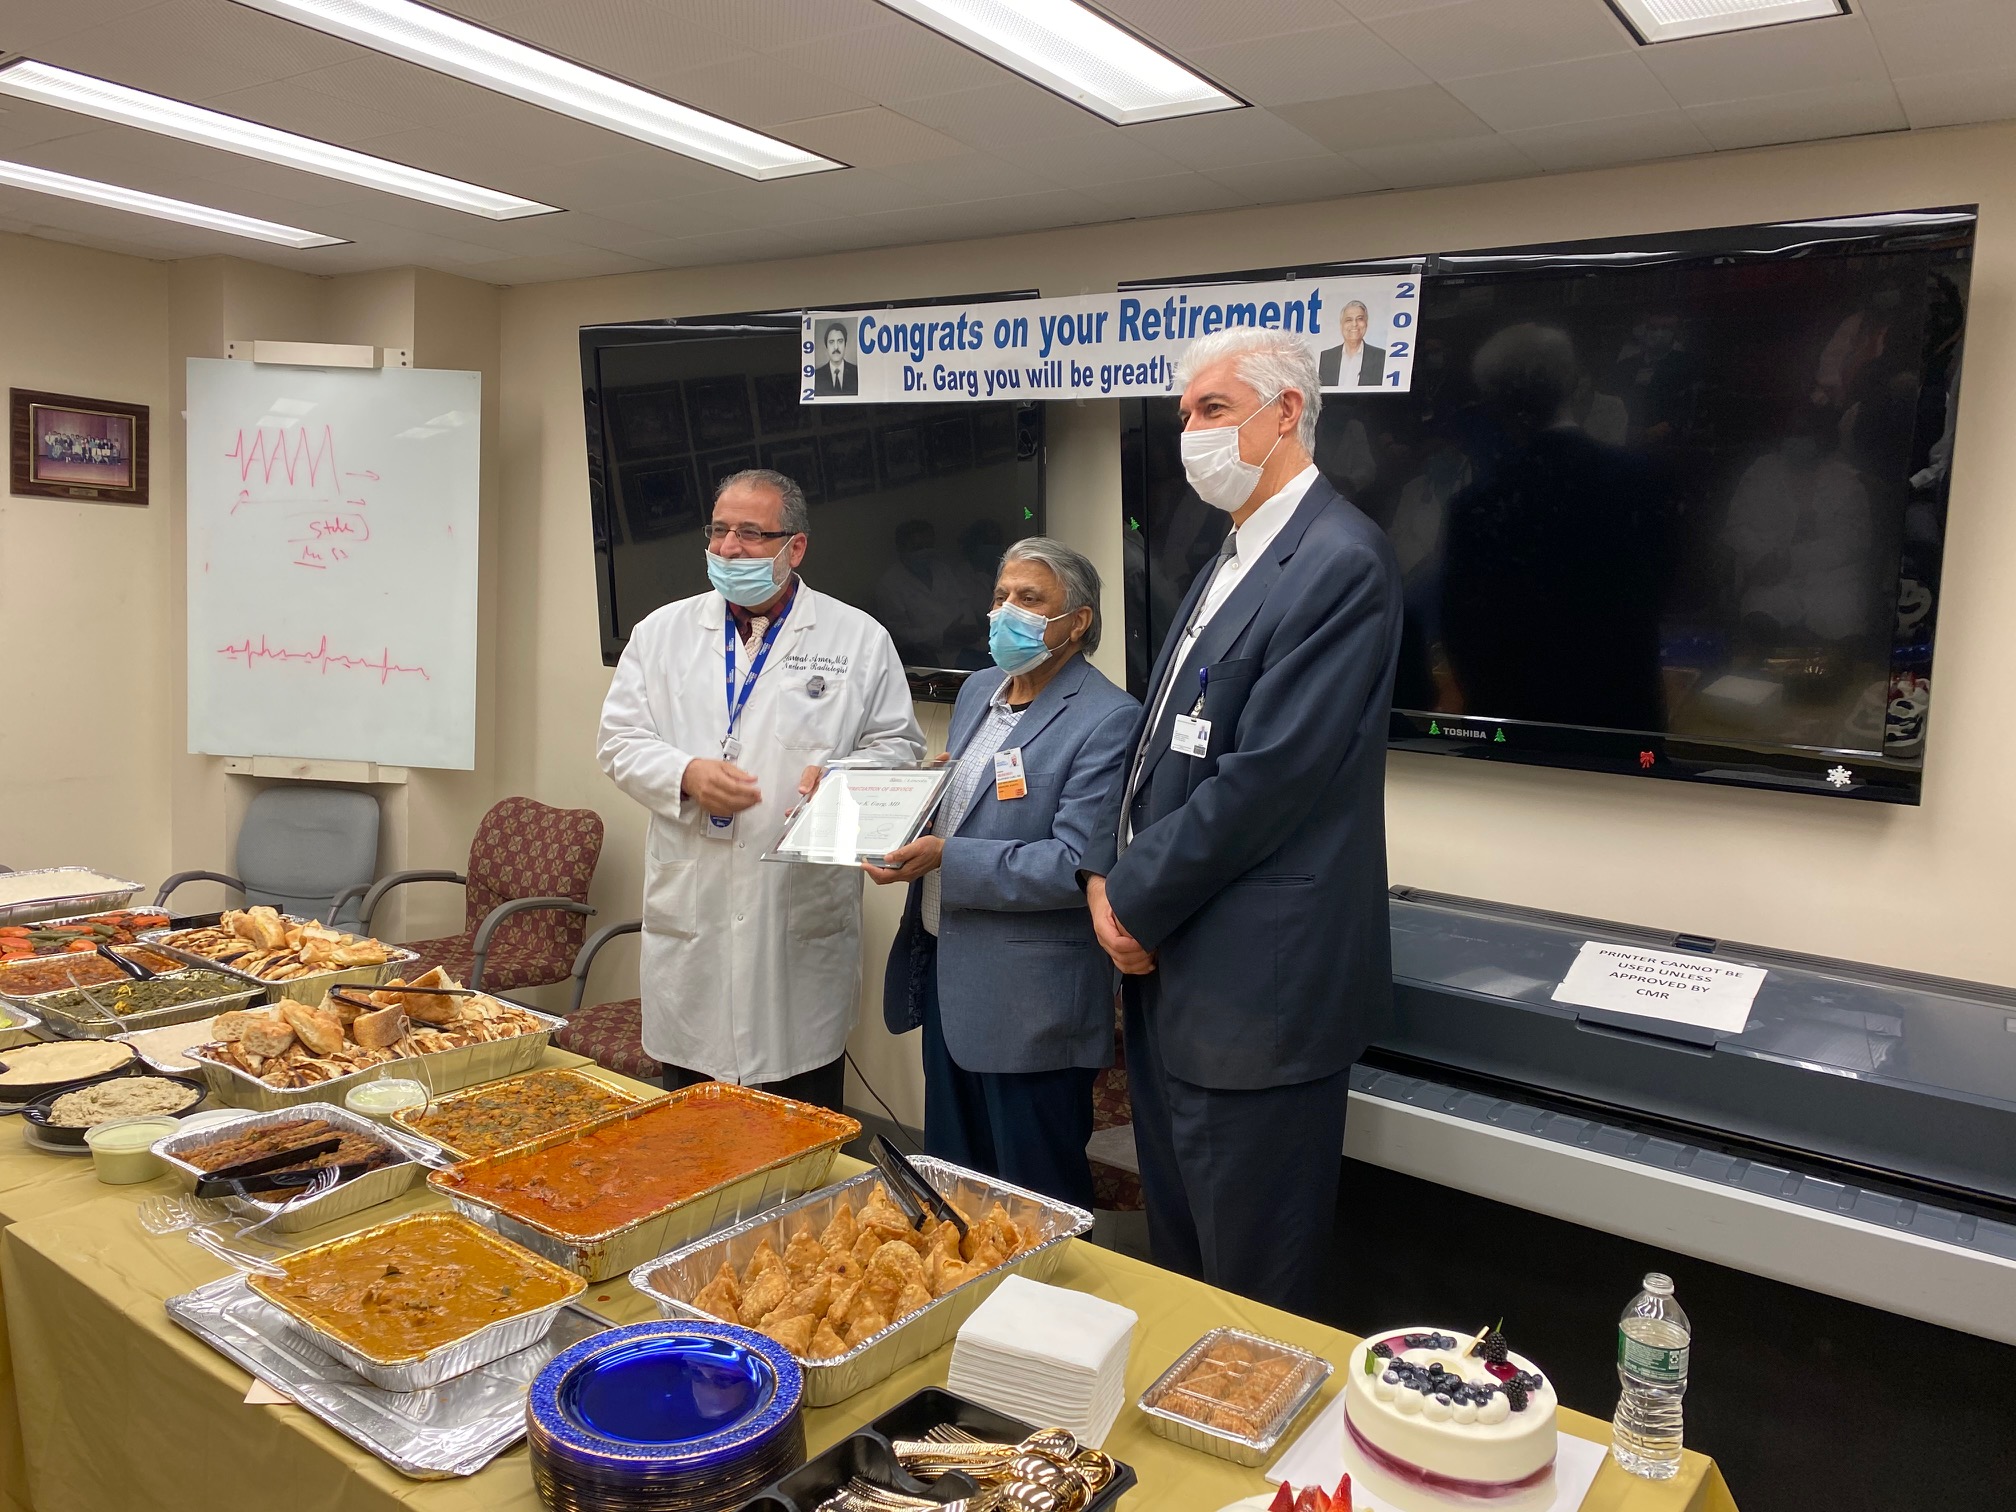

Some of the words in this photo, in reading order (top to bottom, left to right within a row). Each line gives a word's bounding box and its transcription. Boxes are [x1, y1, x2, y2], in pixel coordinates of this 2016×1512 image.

[858, 311, 984, 363] Congrats
[993, 317, 1029, 349] on
[1038, 311, 1109, 358] your
[1118, 287, 1323, 342] Retirement
[903, 365, 927, 391] Dr.
[933, 364, 979, 397] Garg
[984, 368, 1021, 397] you
[1025, 360, 1062, 388] will
[1070, 359, 1094, 388] be
[1100, 354, 1176, 393] greatly
[810, 662, 848, 675] Radiologist
[1443, 727, 1487, 739] TOSHIBA
[1599, 949, 1657, 964] PRINTER
[1660, 960, 1723, 974] CANNOT
[1725, 970, 1744, 979] BE
[1618, 962, 1655, 973] USED
[1658, 969, 1713, 983] UNLESS
[1608, 971, 1687, 989] APPROVED
[1690, 984, 1711, 993] BY
[1636, 988, 1670, 1000] CMR
